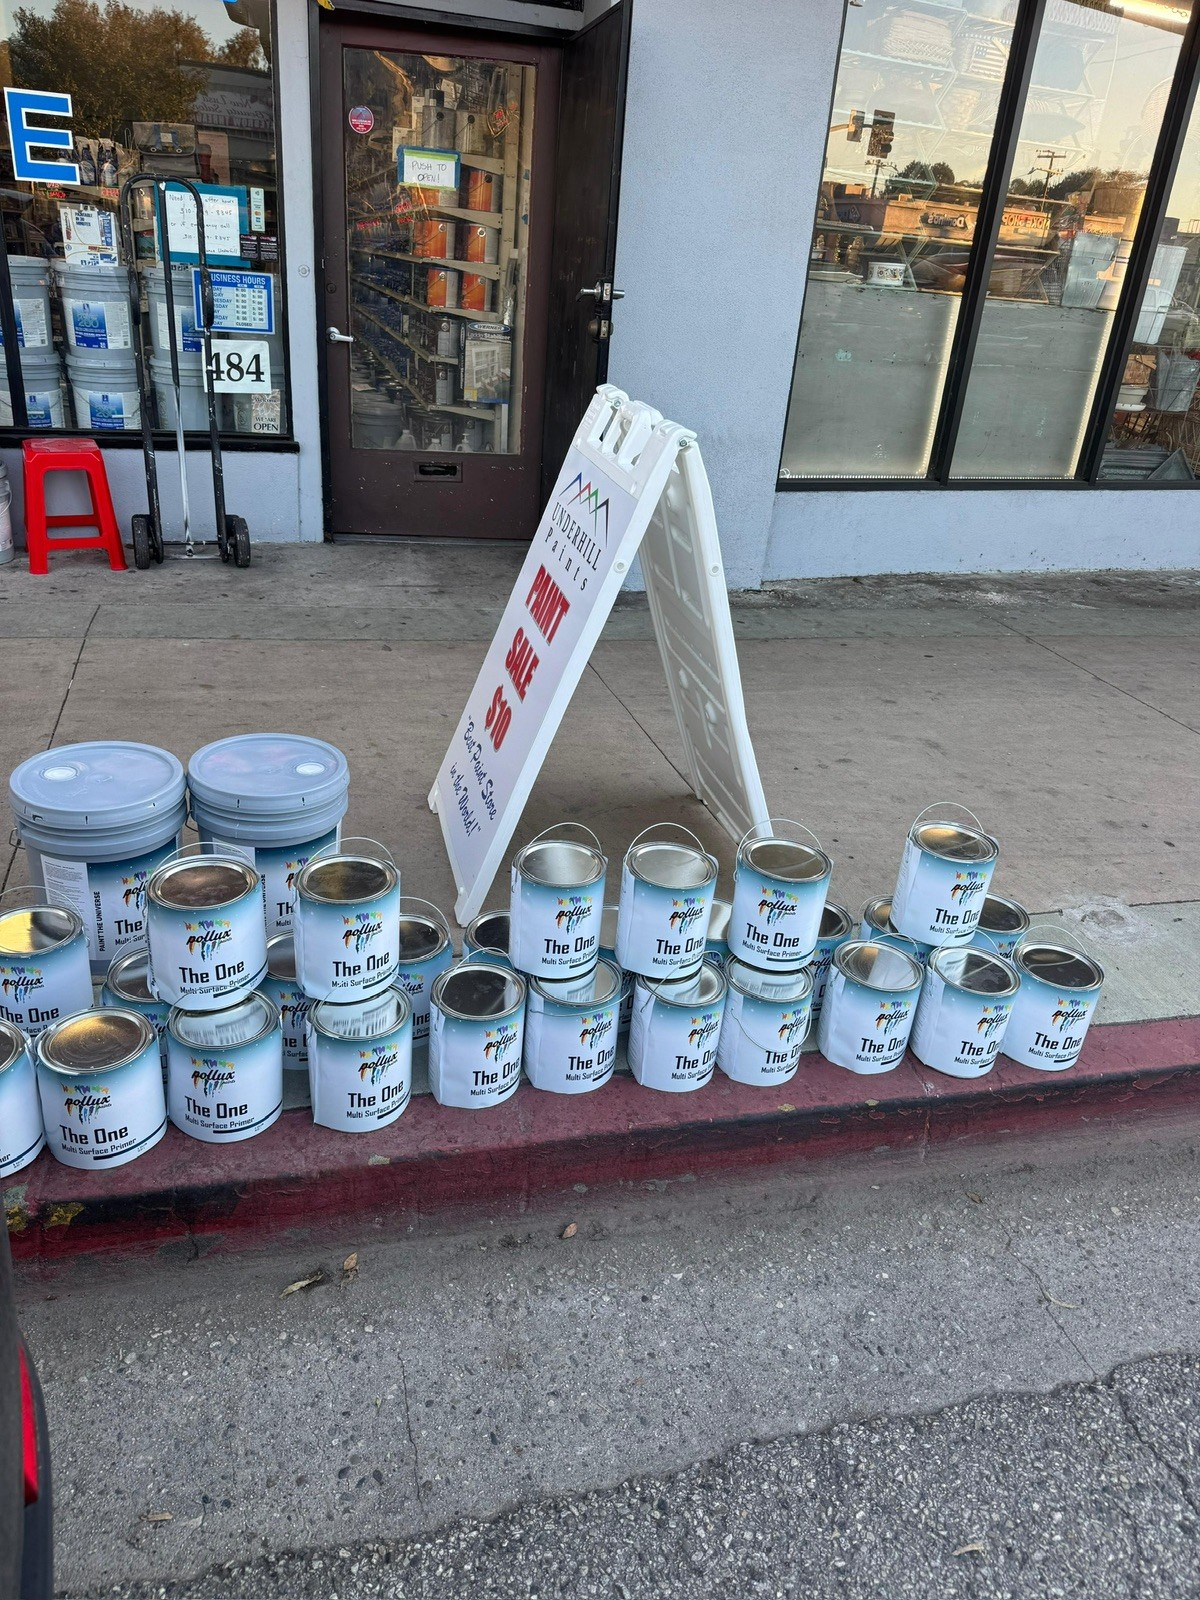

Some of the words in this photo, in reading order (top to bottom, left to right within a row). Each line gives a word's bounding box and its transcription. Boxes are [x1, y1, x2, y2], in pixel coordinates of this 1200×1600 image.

[3, 87, 80, 185] E
[412, 161, 432, 171] PUSH
[437, 163, 447, 171] TO
[417, 173, 440, 183] OPEN!
[210, 273, 241, 284] USINESS
[242, 275, 266, 285] HOURS
[207, 352, 265, 382] 484
[253, 423, 278, 431] OPEN
[552, 502, 601, 571] UNDERHILL
[545, 527, 588, 591] Paints
[525, 563, 570, 646] PAINT
[505, 626, 540, 704] SALE
[484, 683, 512, 752] $10
[453, 774, 464, 795] the
[470, 743, 487, 785] Paint
[481, 779, 497, 820] Store
[94, 891, 102, 921] UNIVERSE
[276, 902, 293, 916] Th
[555, 904, 593, 920] pollux
[669, 906, 704, 921] pollux
[758, 899, 797, 912] pollux
[935, 908, 959, 925] The
[114, 920, 142, 935] The
[342, 920, 383, 940] pollux
[747, 923, 768, 945] The
[775, 932, 799, 947] One
[929, 925, 945, 934] Multi
[186, 928, 232, 945] pollux
[544, 939, 570, 955] The
[574, 935, 595, 952] One
[656, 938, 680, 955] The
[685, 936, 704, 953] One
[742, 939, 755, 951] Multi
[756, 946, 781, 957] Surface
[782, 950, 802, 958] Primer
[332, 961, 361, 977] The
[366, 952, 390, 971] One
[542, 957, 557, 965] Multi
[558, 956, 581, 965] Surface
[652, 957, 668, 966] Multi
[179, 966, 210, 984] The
[215, 961, 245, 981] One
[2, 976, 43, 987] pollux
[350, 976, 376, 987] Surface
[0, 1005, 23, 1023] The
[28, 1008, 59, 1023] One
[281, 1002, 311, 1012] pollu
[1052, 1008, 1088, 1018] pollux
[861, 1037, 884, 1053] The
[888, 1036, 906, 1051] One
[961, 1041, 983, 1056] The
[1035, 1032, 1058, 1050] The
[1063, 1037, 1082, 1050] One
[358, 1051, 399, 1072] pollux
[568, 1056, 593, 1071] The
[597, 1046, 615, 1065] One
[765, 1050, 787, 1064] The
[856, 1054, 871, 1062] Multi
[954, 1056, 969, 1065] Multi
[1028, 1047, 1044, 1057] Multi
[1044, 1052, 1066, 1060] Surface
[675, 1055, 698, 1070] The
[761, 1066, 776, 1074] Multi
[191, 1069, 235, 1081] pollux
[472, 1070, 498, 1086] The
[502, 1057, 520, 1079] One
[565, 1073, 581, 1081] Multi
[671, 1072, 687, 1080] Multi
[348, 1092, 376, 1108] The
[381, 1080, 404, 1103] One
[470, 1088, 487, 1096] Multi
[64, 1095, 111, 1106] pollux
[184, 1095, 211, 1118] The
[216, 1103, 248, 1118] One
[347, 1111, 363, 1119] Multi
[364, 1105, 391, 1117] Surface
[185, 1113, 199, 1126] Multi
[200, 1119, 228, 1129] Surface
[230, 1117, 255, 1128] Primer
[59, 1124, 89, 1145] The
[94, 1126, 129, 1144] One
[61, 1143, 77, 1154] Multi
[78, 1147, 109, 1155] Surface
[110, 1138, 137, 1152] Primer
